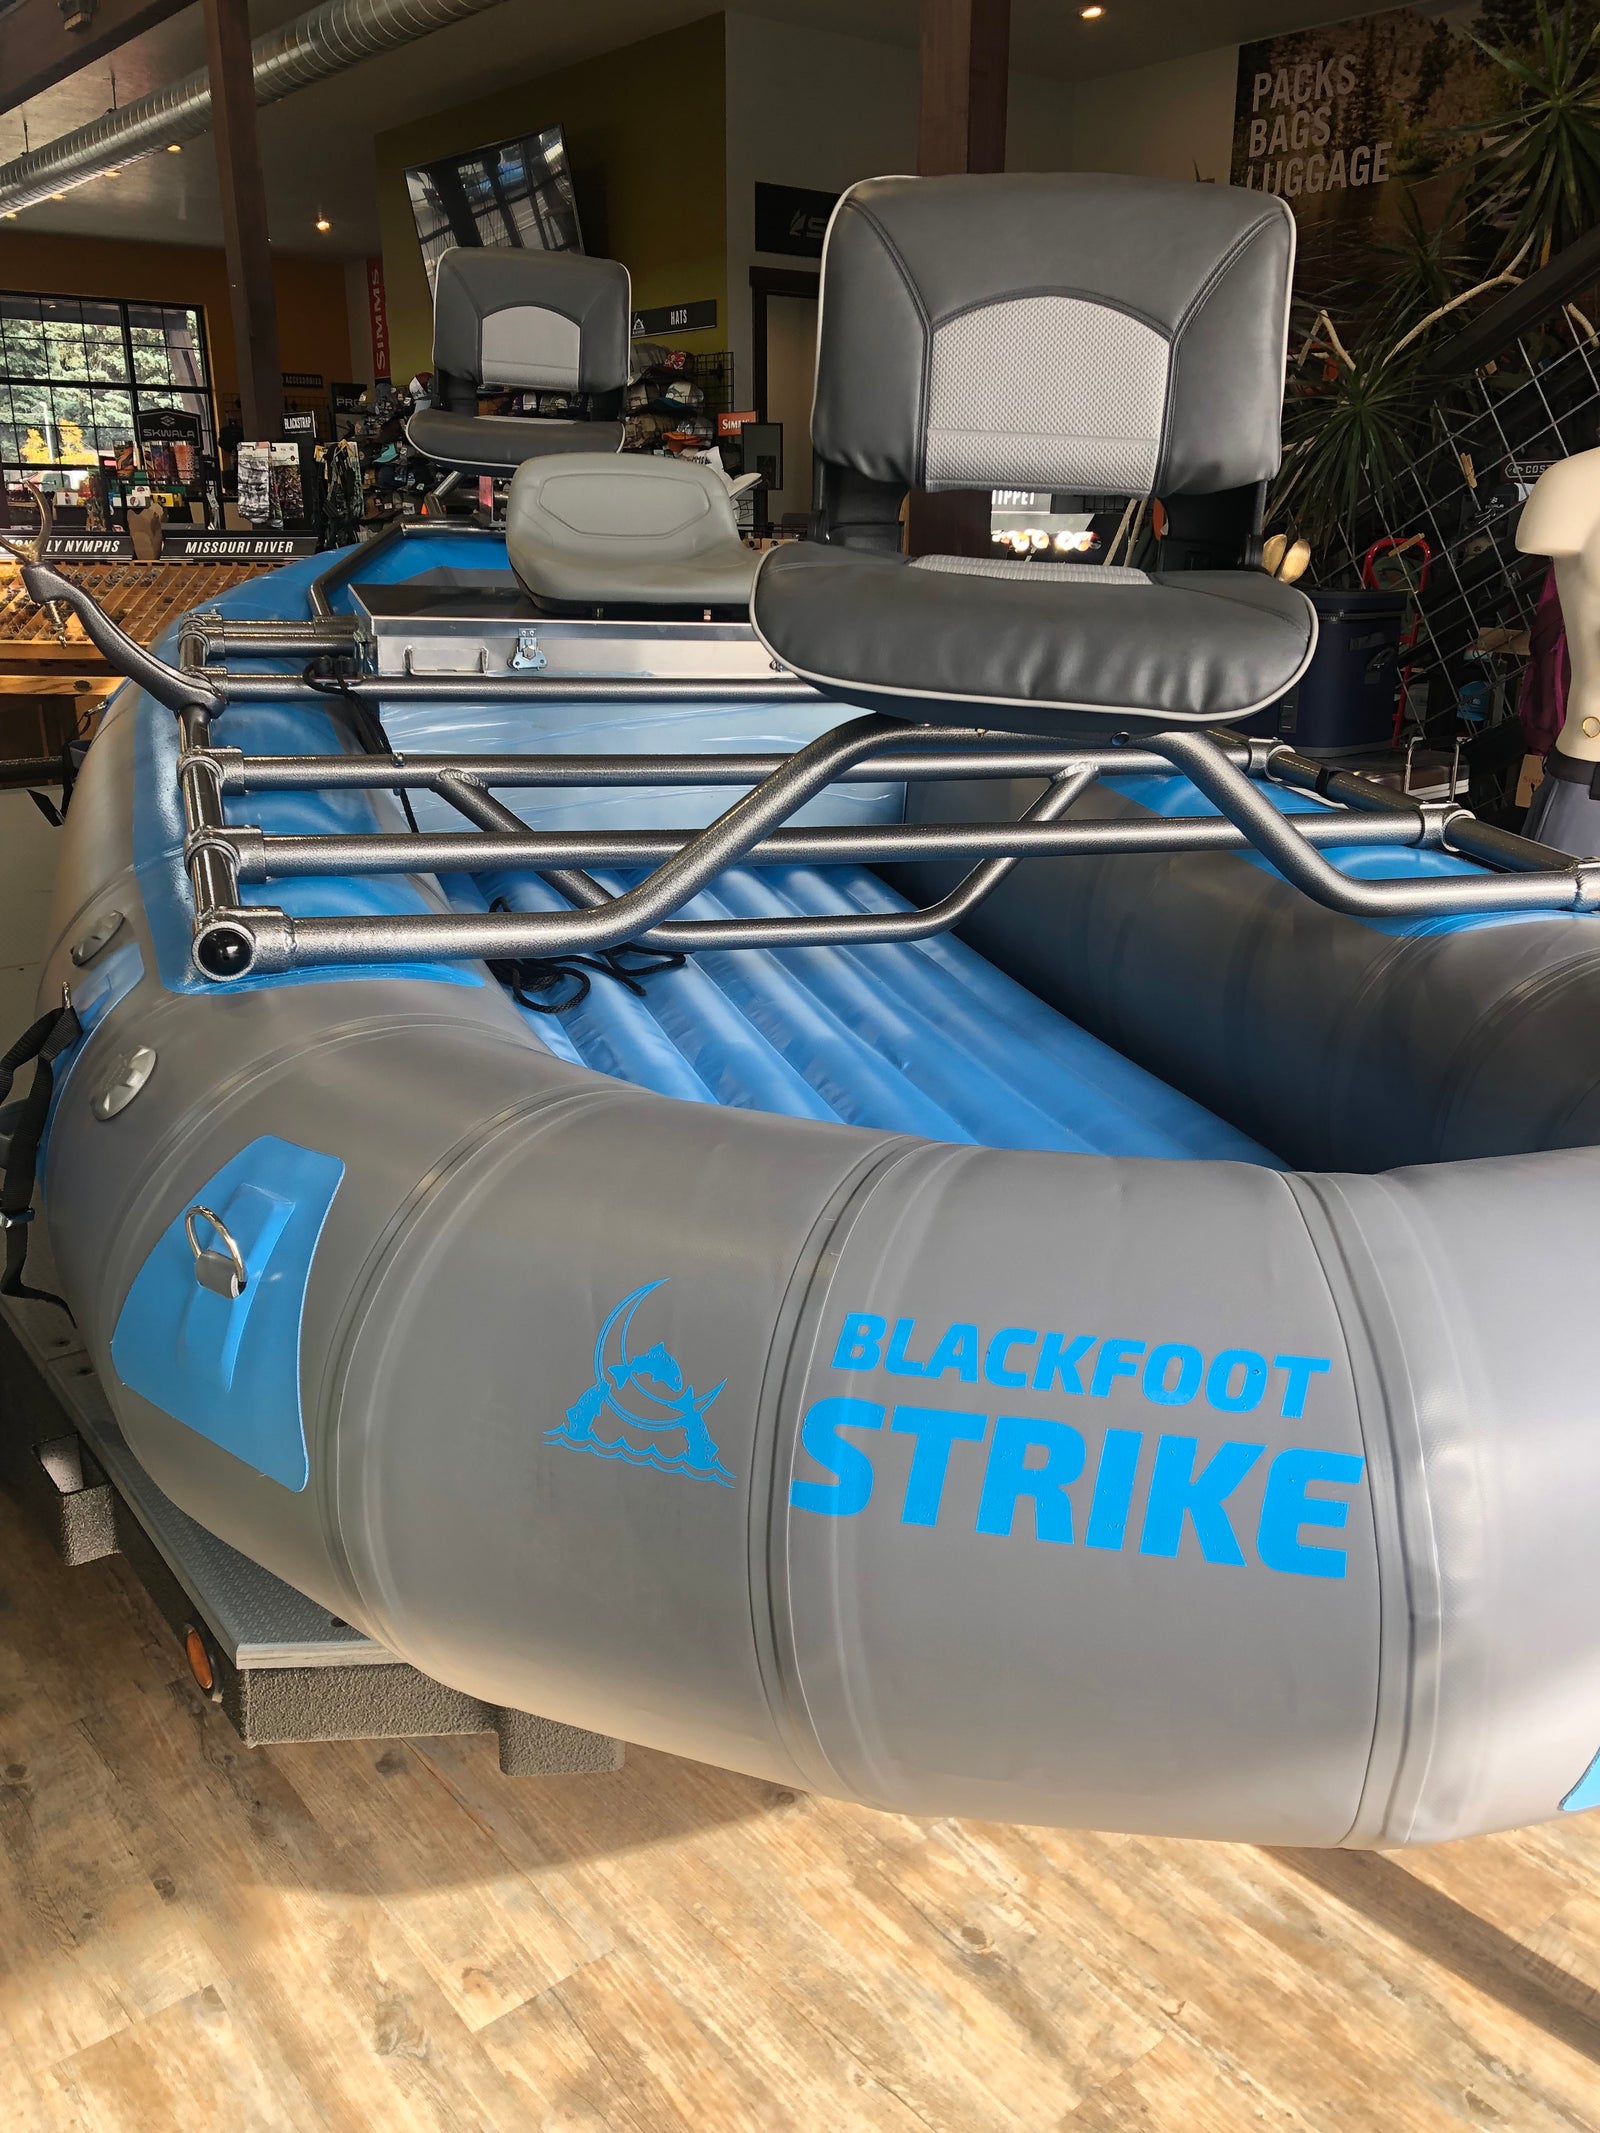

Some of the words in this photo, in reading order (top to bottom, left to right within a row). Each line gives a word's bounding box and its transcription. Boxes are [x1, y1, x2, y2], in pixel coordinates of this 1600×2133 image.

[1252, 54, 1357, 112] PACKS
[1249, 106, 1331, 158] BAGS
[1247, 142, 1392, 198] LUGGAGE
[372, 270, 386, 370] SIMMS
[670, 309, 688, 326] HATS
[143, 428, 195, 438] SKWALA
[283, 416, 312, 430] BLACKSTRAP
[1525, 464, 1552, 474] COS
[64, 540, 120, 553] NYMPHS
[185, 541, 251, 554] MISSOURI
[253, 541, 294, 554] RIVER
[831, 1312, 1331, 1419] BLACKFOOT
[789, 1396, 1366, 1580] STRIKE
